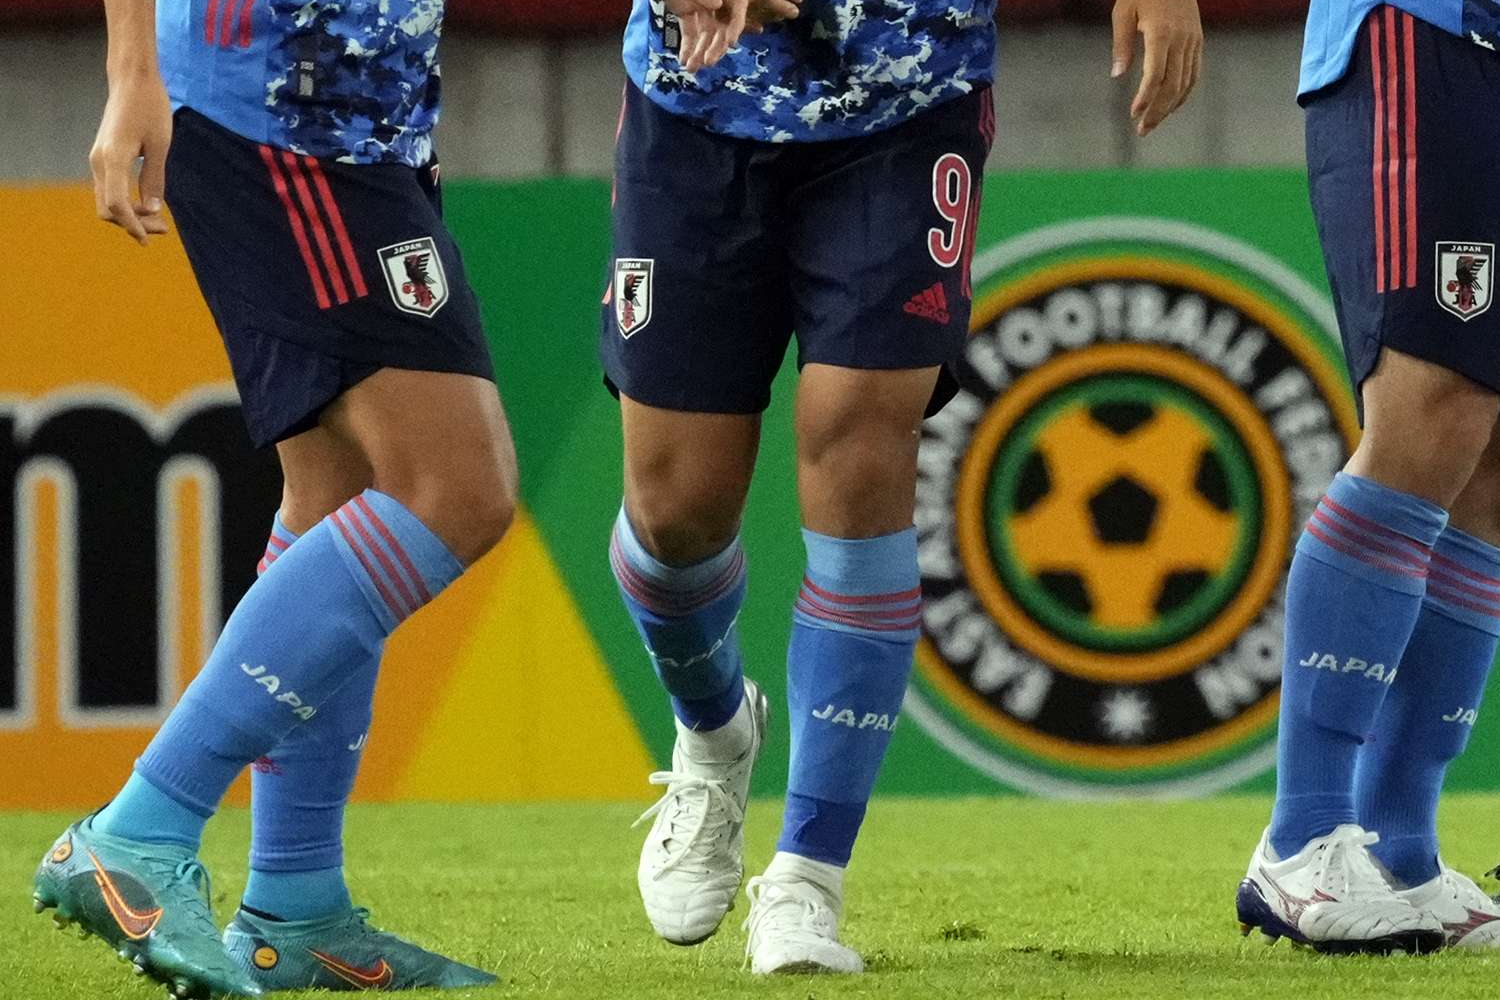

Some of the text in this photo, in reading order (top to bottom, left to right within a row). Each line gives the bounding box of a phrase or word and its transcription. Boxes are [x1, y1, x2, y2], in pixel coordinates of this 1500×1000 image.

[928, 153, 972, 268] 9
[393, 242, 423, 255] JAPAN
[1450, 244, 1482, 253] JAPAN
[965, 281, 1272, 392] FOOTBALL
[239, 662, 318, 720] JAPA
[1442, 706, 1479, 727] JA
